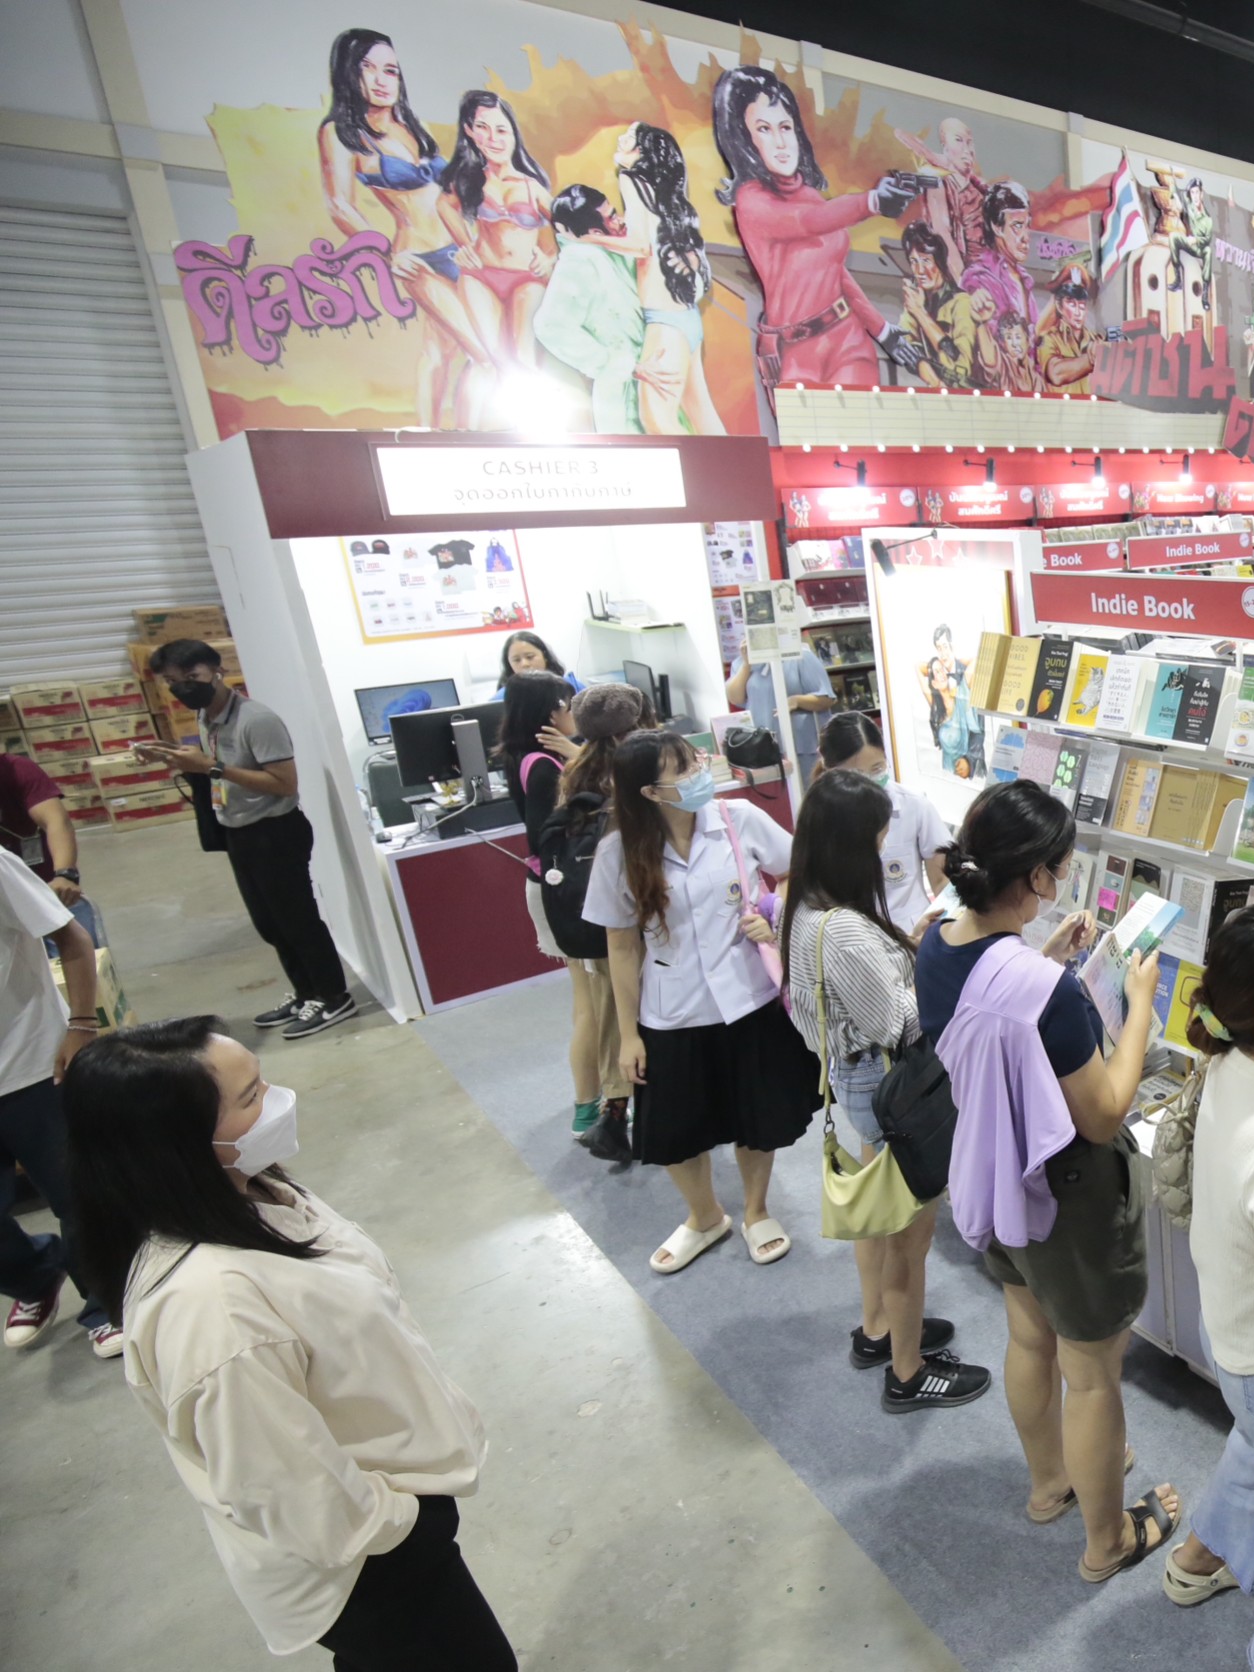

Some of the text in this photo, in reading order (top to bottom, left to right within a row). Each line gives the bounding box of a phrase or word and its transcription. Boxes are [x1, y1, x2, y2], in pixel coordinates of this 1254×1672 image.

[172, 231, 416, 366] ดีลรัก
[1089, 318, 1236, 401] มติชน
[482, 460, 599, 476] CASHIER 3
[453, 481, 632, 506] จุดออกใบกำกับภาษี
[1050, 552, 1082, 567] Book
[1165, 541, 1221, 558] Indie Book
[1090, 591, 1196, 621] Indie Book
[1044, 657, 1067, 670] จูบกบ
